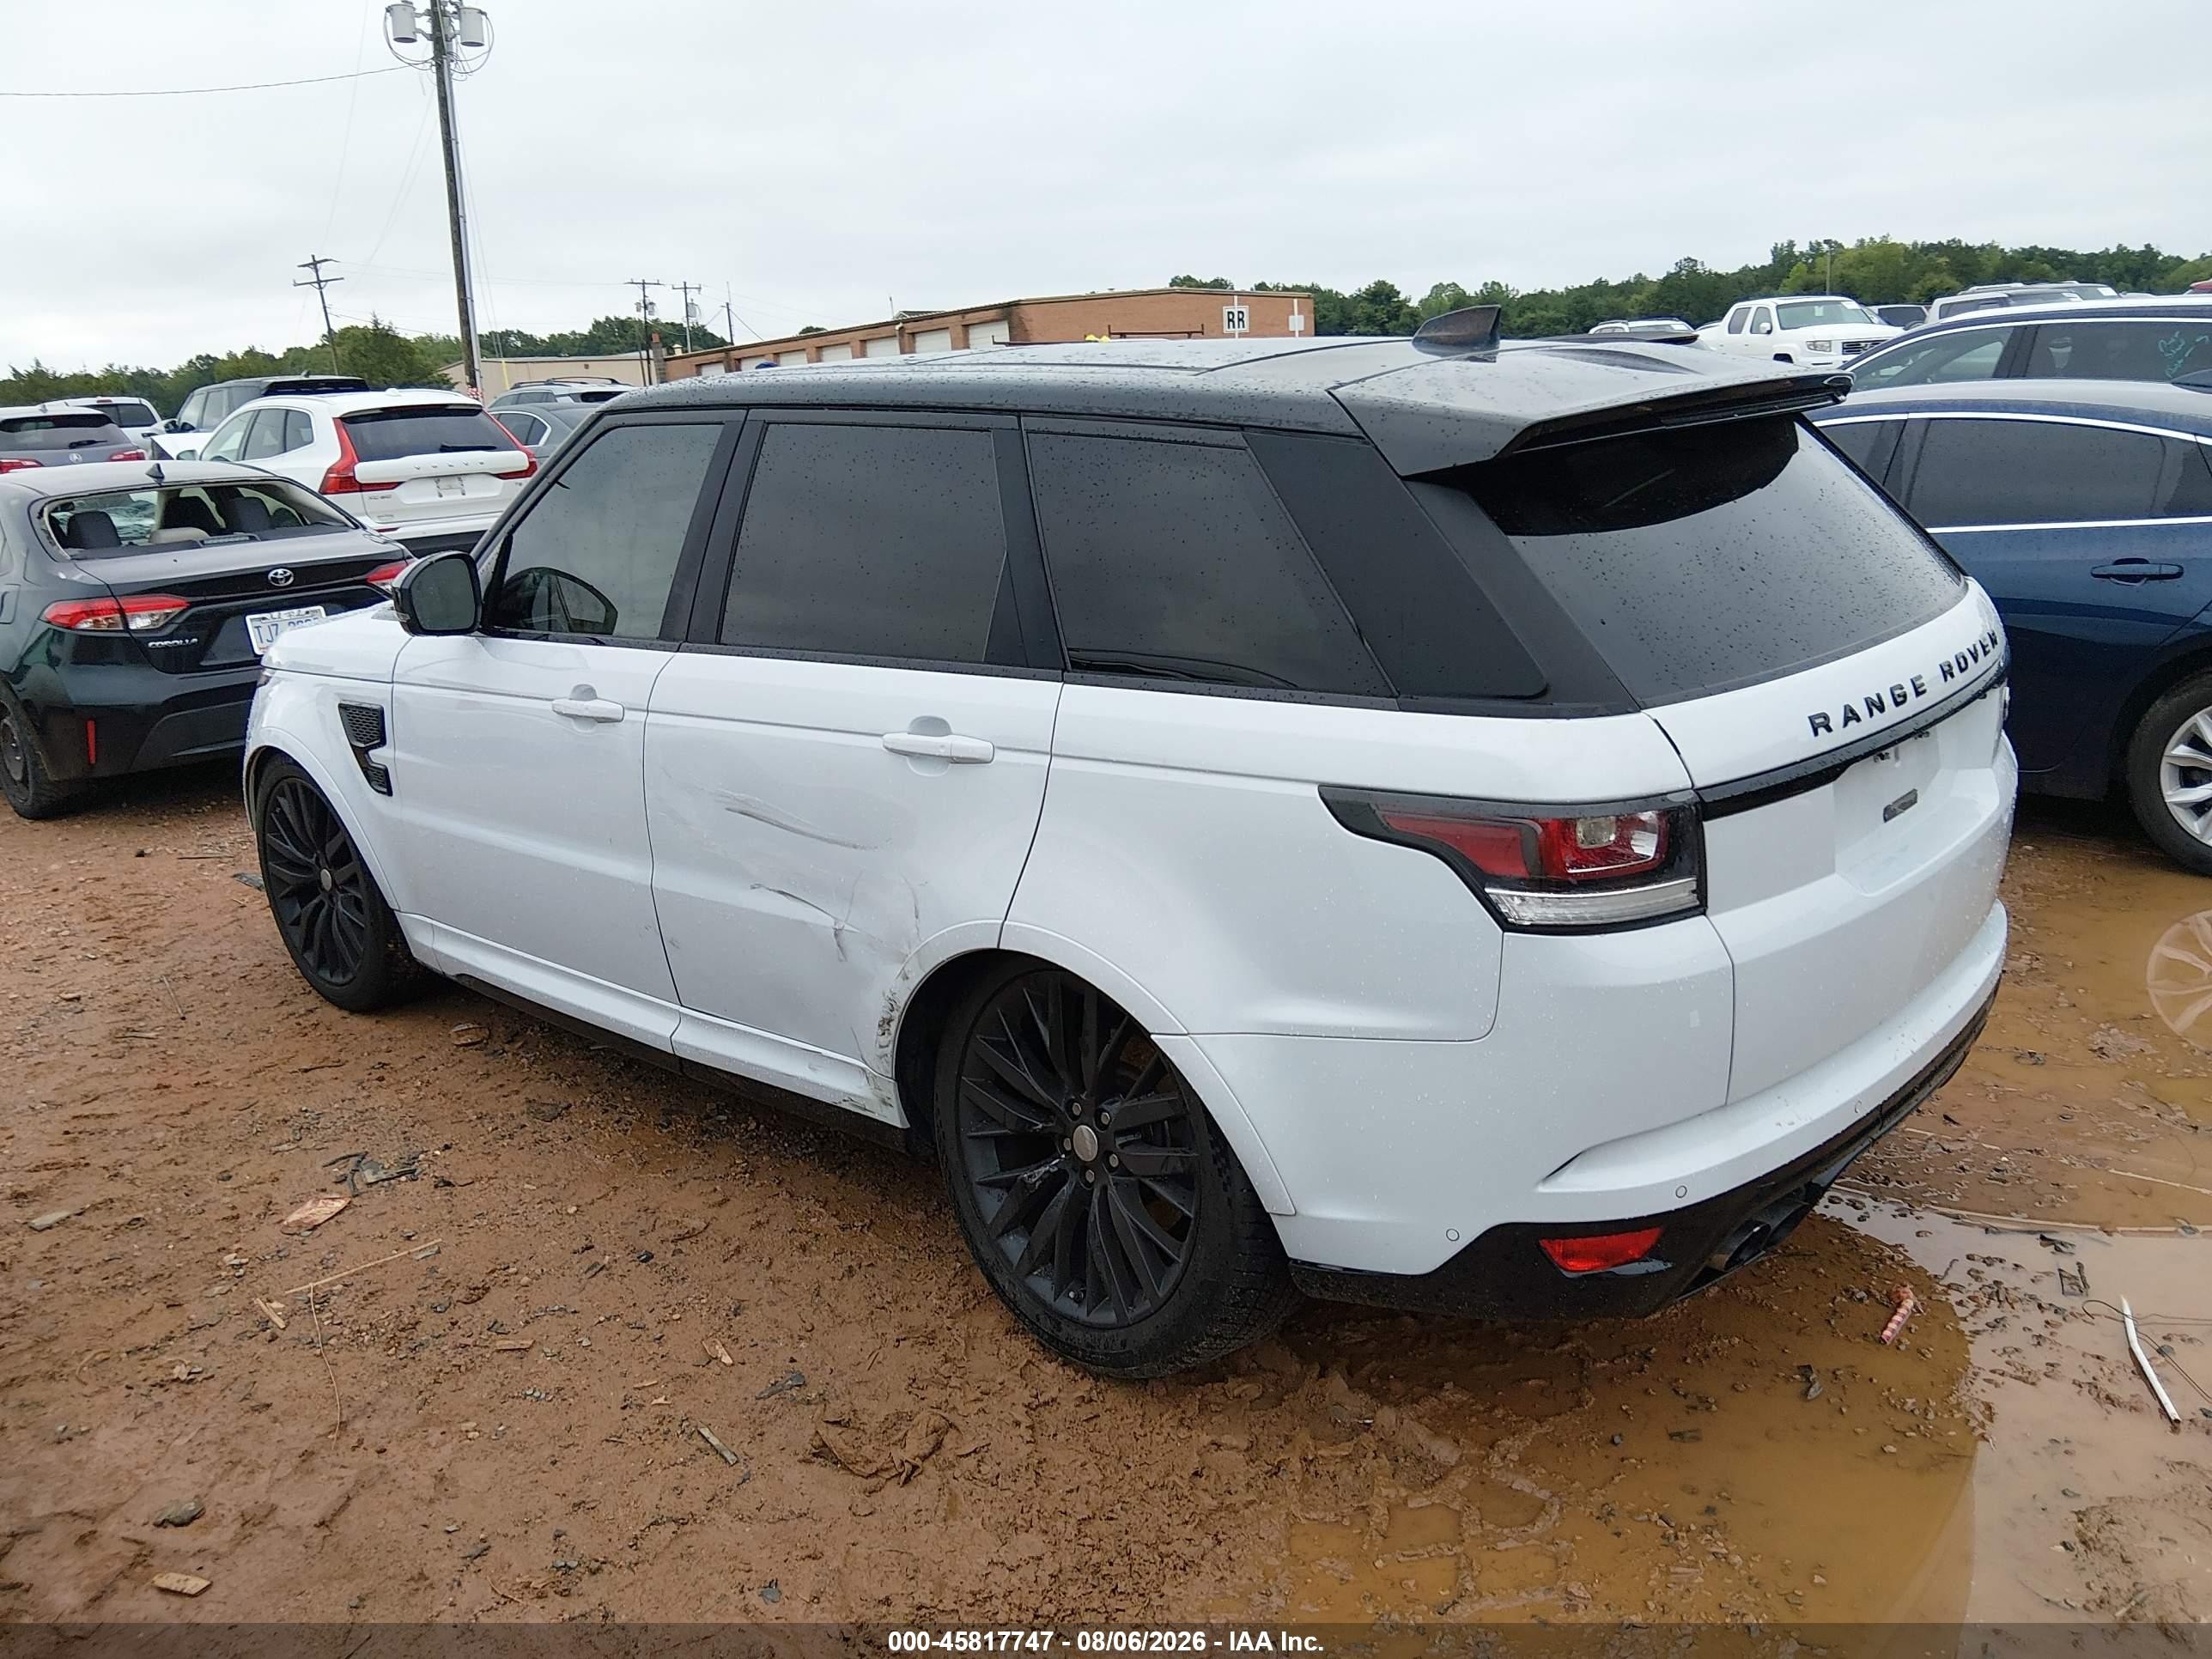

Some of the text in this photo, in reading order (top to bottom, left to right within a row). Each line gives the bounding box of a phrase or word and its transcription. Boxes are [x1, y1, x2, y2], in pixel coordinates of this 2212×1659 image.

[1227, 310, 1246, 330] RR
[1808, 629, 1999, 737] RANGE ROVER
